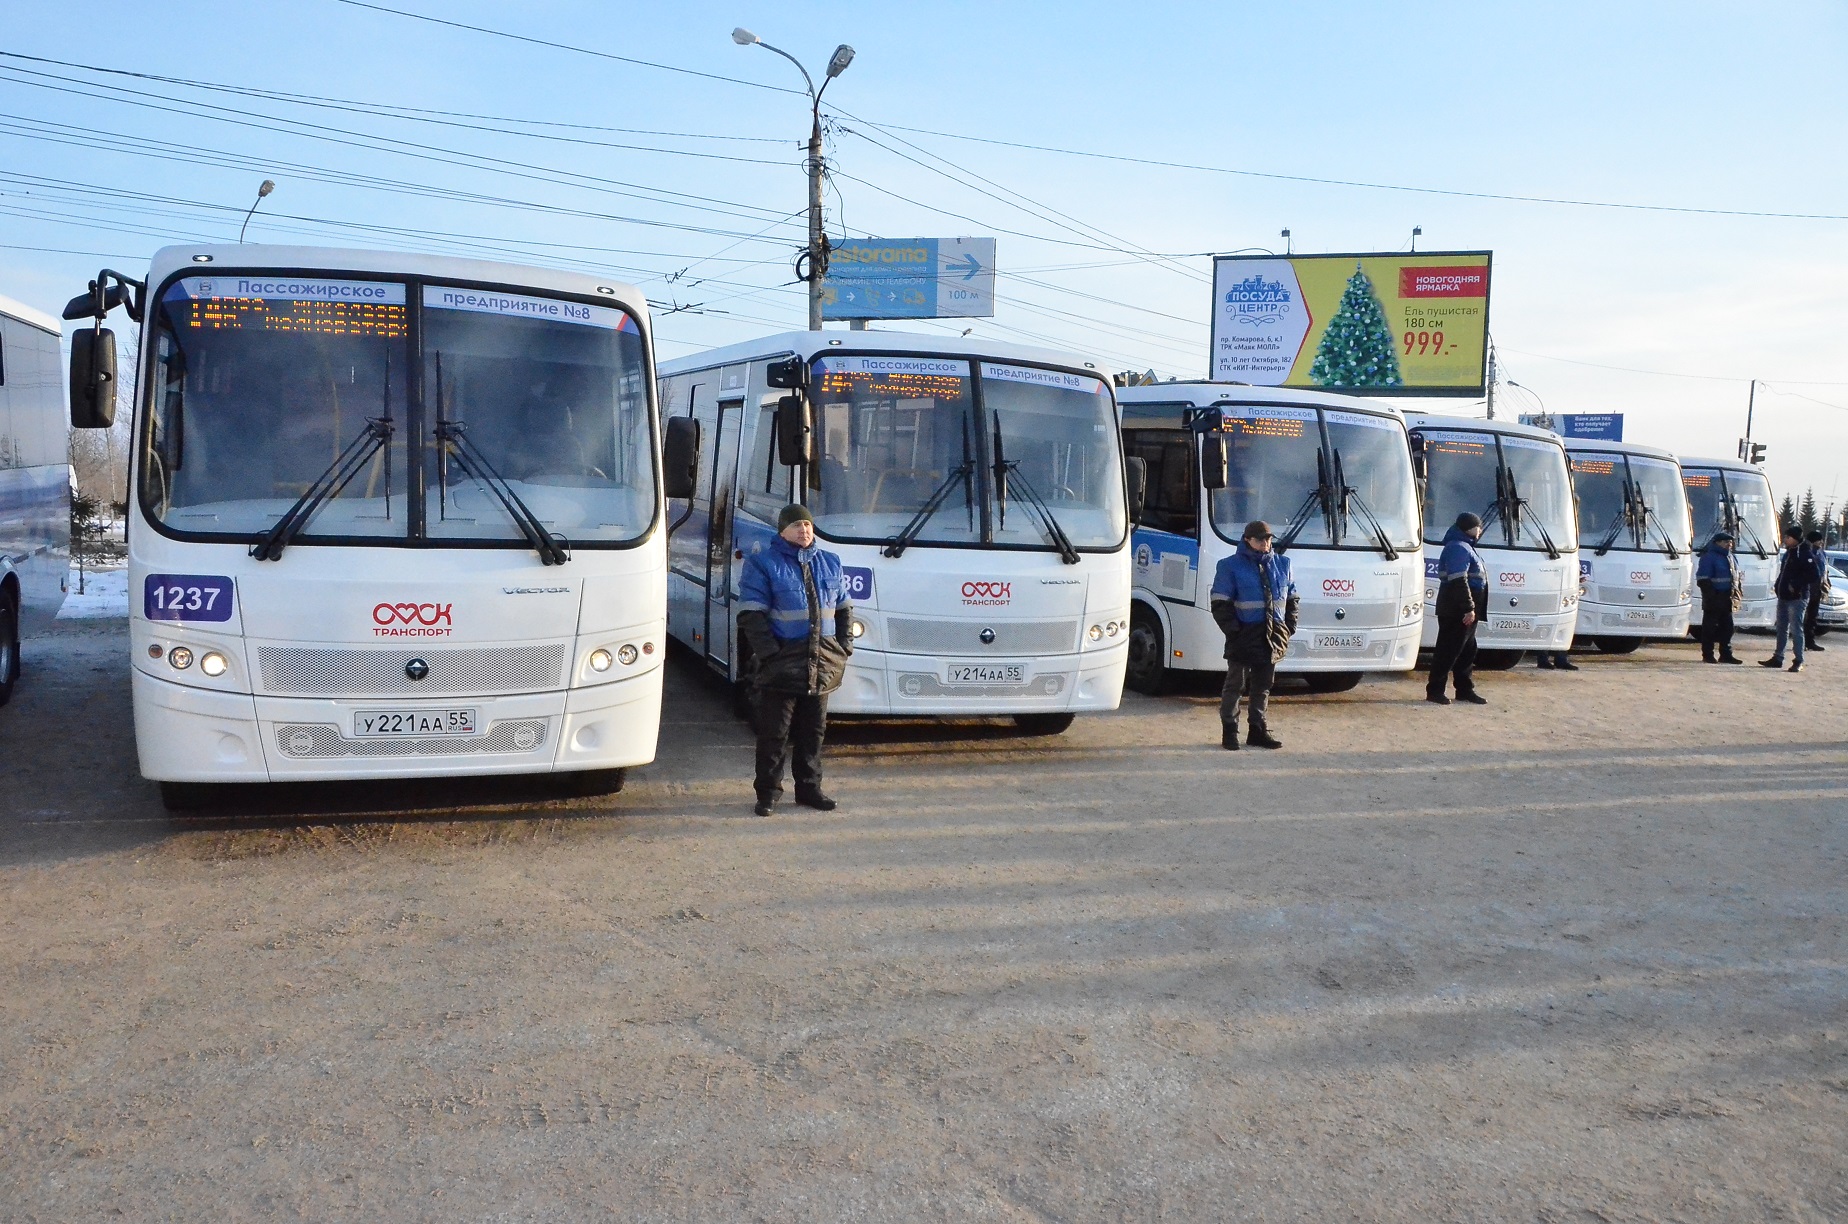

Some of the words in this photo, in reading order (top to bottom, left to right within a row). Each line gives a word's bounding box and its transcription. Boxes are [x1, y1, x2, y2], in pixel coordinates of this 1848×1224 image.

[829, 246, 928, 264] astorama
[1416, 276, 1480, 284] НОВОГОДНЯЯ
[238, 280, 386, 299] Пассажирское
[443, 292, 559, 316] предприятие
[563, 304, 591, 320] №8
[948, 290, 967, 299] 100
[1232, 291, 1284, 302] ПОСУДА
[1239, 304, 1278, 313] ЦЕНТР
[1404, 306, 1424, 316] Ель
[1427, 307, 1479, 317] пушистая
[1404, 318, 1425, 328] 180
[1428, 320, 1443, 328] см
[1220, 336, 1230, 344] пр.
[1403, 331, 1458, 356] 999.-
[862, 359, 957, 372] Пассажирское
[989, 366, 1060, 384] предприятие
[1063, 375, 1080, 387] №8
[1248, 407, 1313, 418] Пассажирское
[843, 575, 864, 592] 36
[153, 586, 221, 611] 1237
[372, 628, 453, 637] ТРАНСПОРТ
